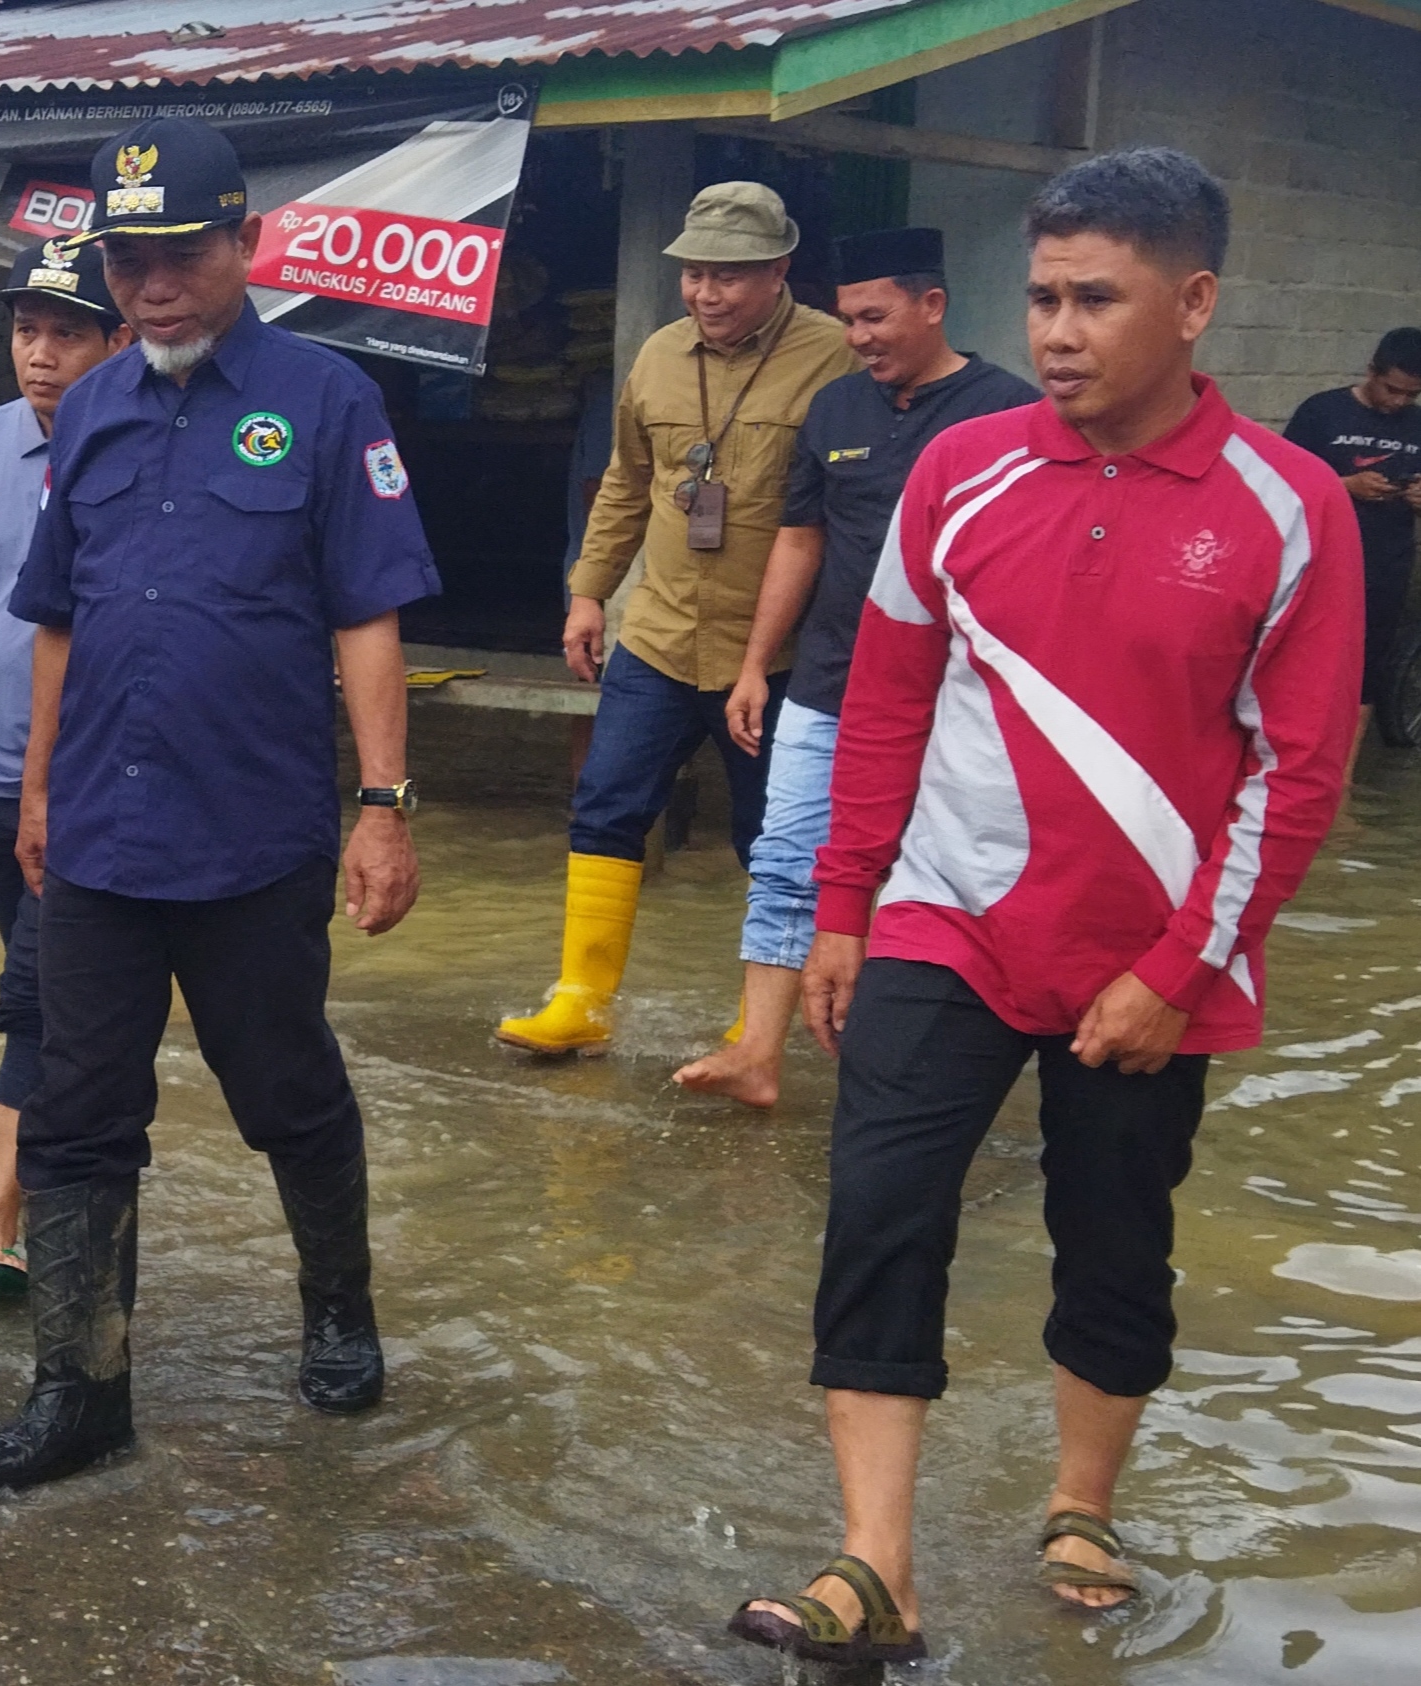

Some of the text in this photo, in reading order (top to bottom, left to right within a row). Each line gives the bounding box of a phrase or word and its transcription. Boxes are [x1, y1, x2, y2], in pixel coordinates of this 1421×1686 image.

[24, 107, 84, 121] LAYANAN
[86, 105, 154, 119] BERHENTI
[155, 102, 227, 118] MEROKOK
[228, 100, 333, 117] (0800-177-6565)
[277, 210, 303, 233] Rp
[280, 265, 477, 314] BUNGKUS / 20 BATANG
[1331, 435, 1375, 446] JUST
[1378, 439, 1402, 451] DO
